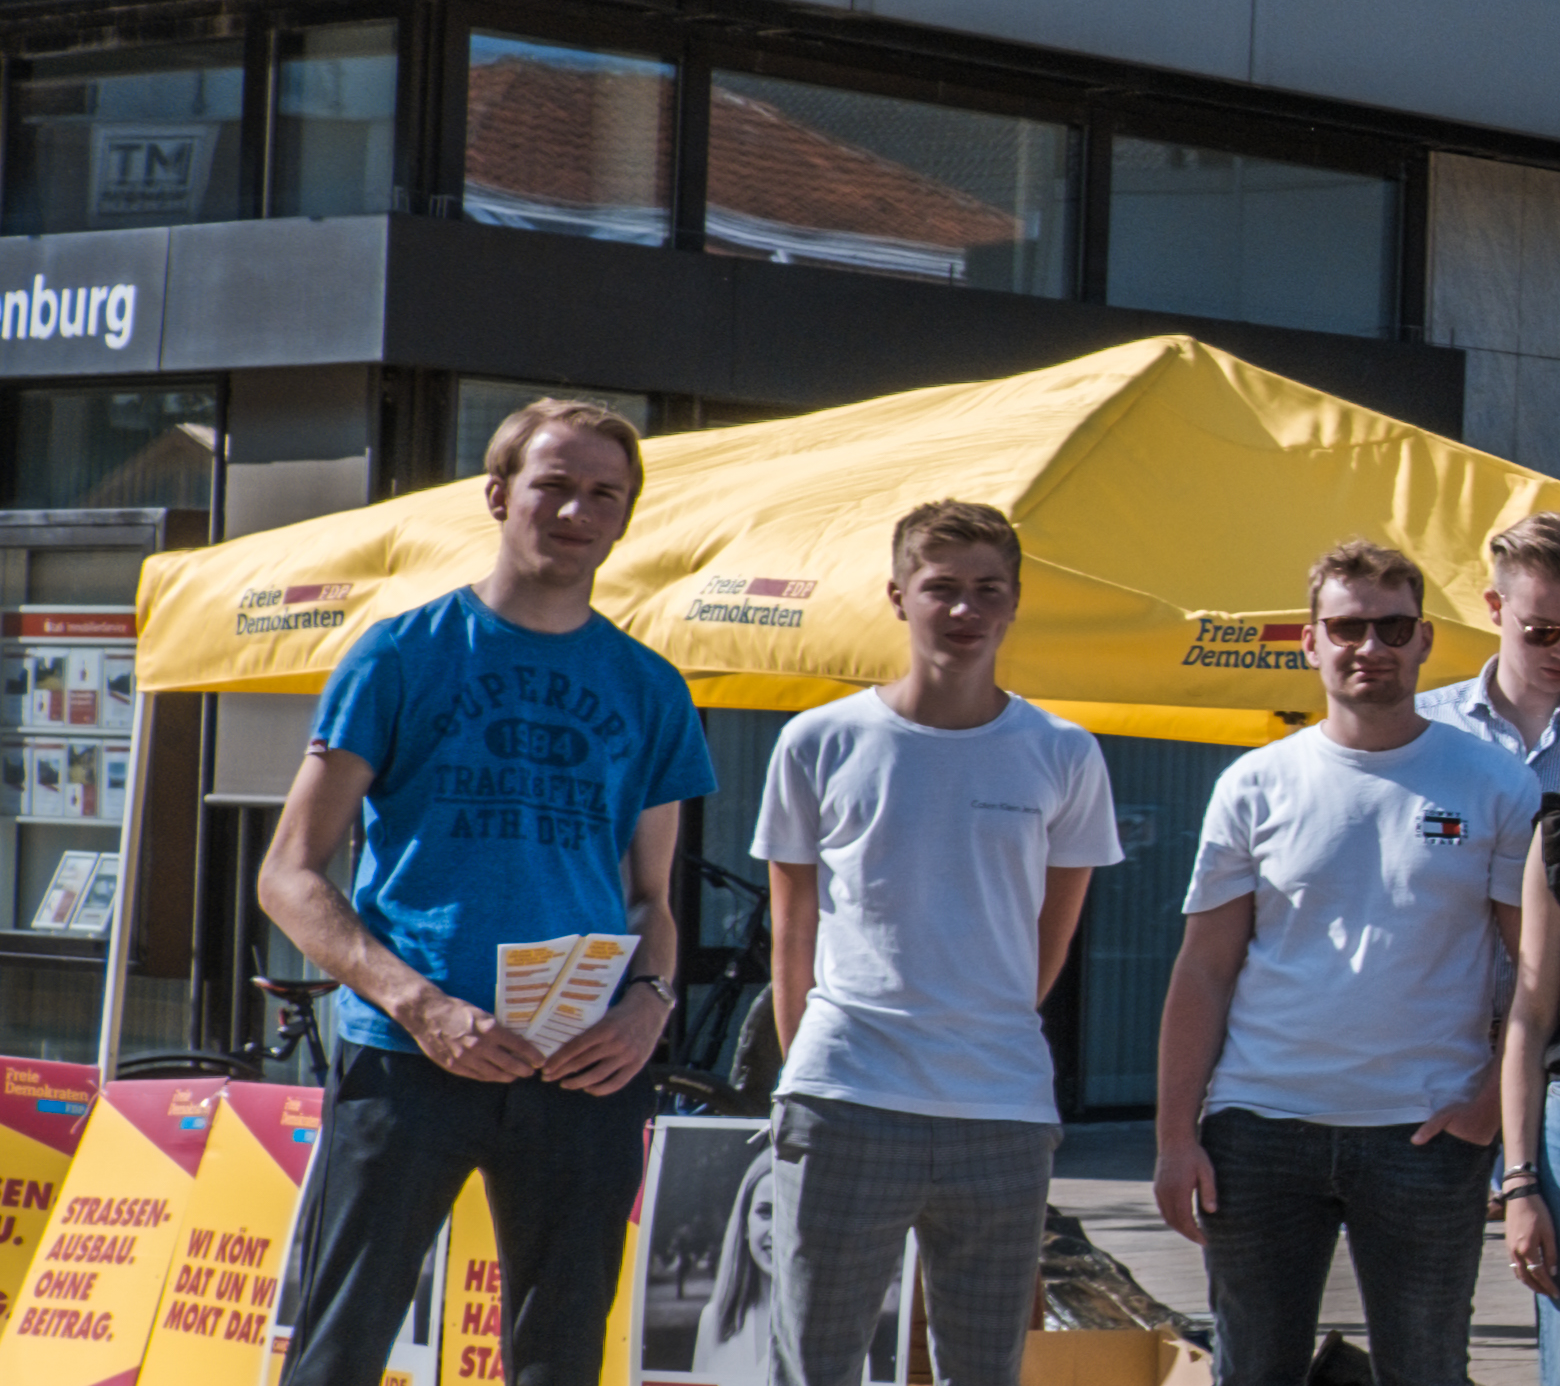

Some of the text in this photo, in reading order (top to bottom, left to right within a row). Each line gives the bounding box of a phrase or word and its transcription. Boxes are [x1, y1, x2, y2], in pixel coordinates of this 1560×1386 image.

[0, 273, 137, 350] nburg
[239, 584, 283, 609] Freie
[699, 573, 747, 595] Freie
[236, 606, 345, 635] Demokraten
[684, 598, 803, 628] Demokraten
[1196, 618, 1259, 643] Freie
[1181, 644, 1309, 670] Demokrat
[61, 1197, 171, 1229] STRASSEN-
[46, 1232, 136, 1266] AUSBAU.
[187, 1226, 271, 1270] WI KÖNT
[34, 1270, 98, 1302] OHNE
[174, 1264, 213, 1297] DAT
[215, 1273, 247, 1304] UN
[465, 1258, 501, 1294] HE
[18, 1307, 114, 1342] BEITRAG.
[163, 1299, 223, 1338] MOKT
[224, 1311, 266, 1347] DAT.
[461, 1294, 502, 1337] HÄ
